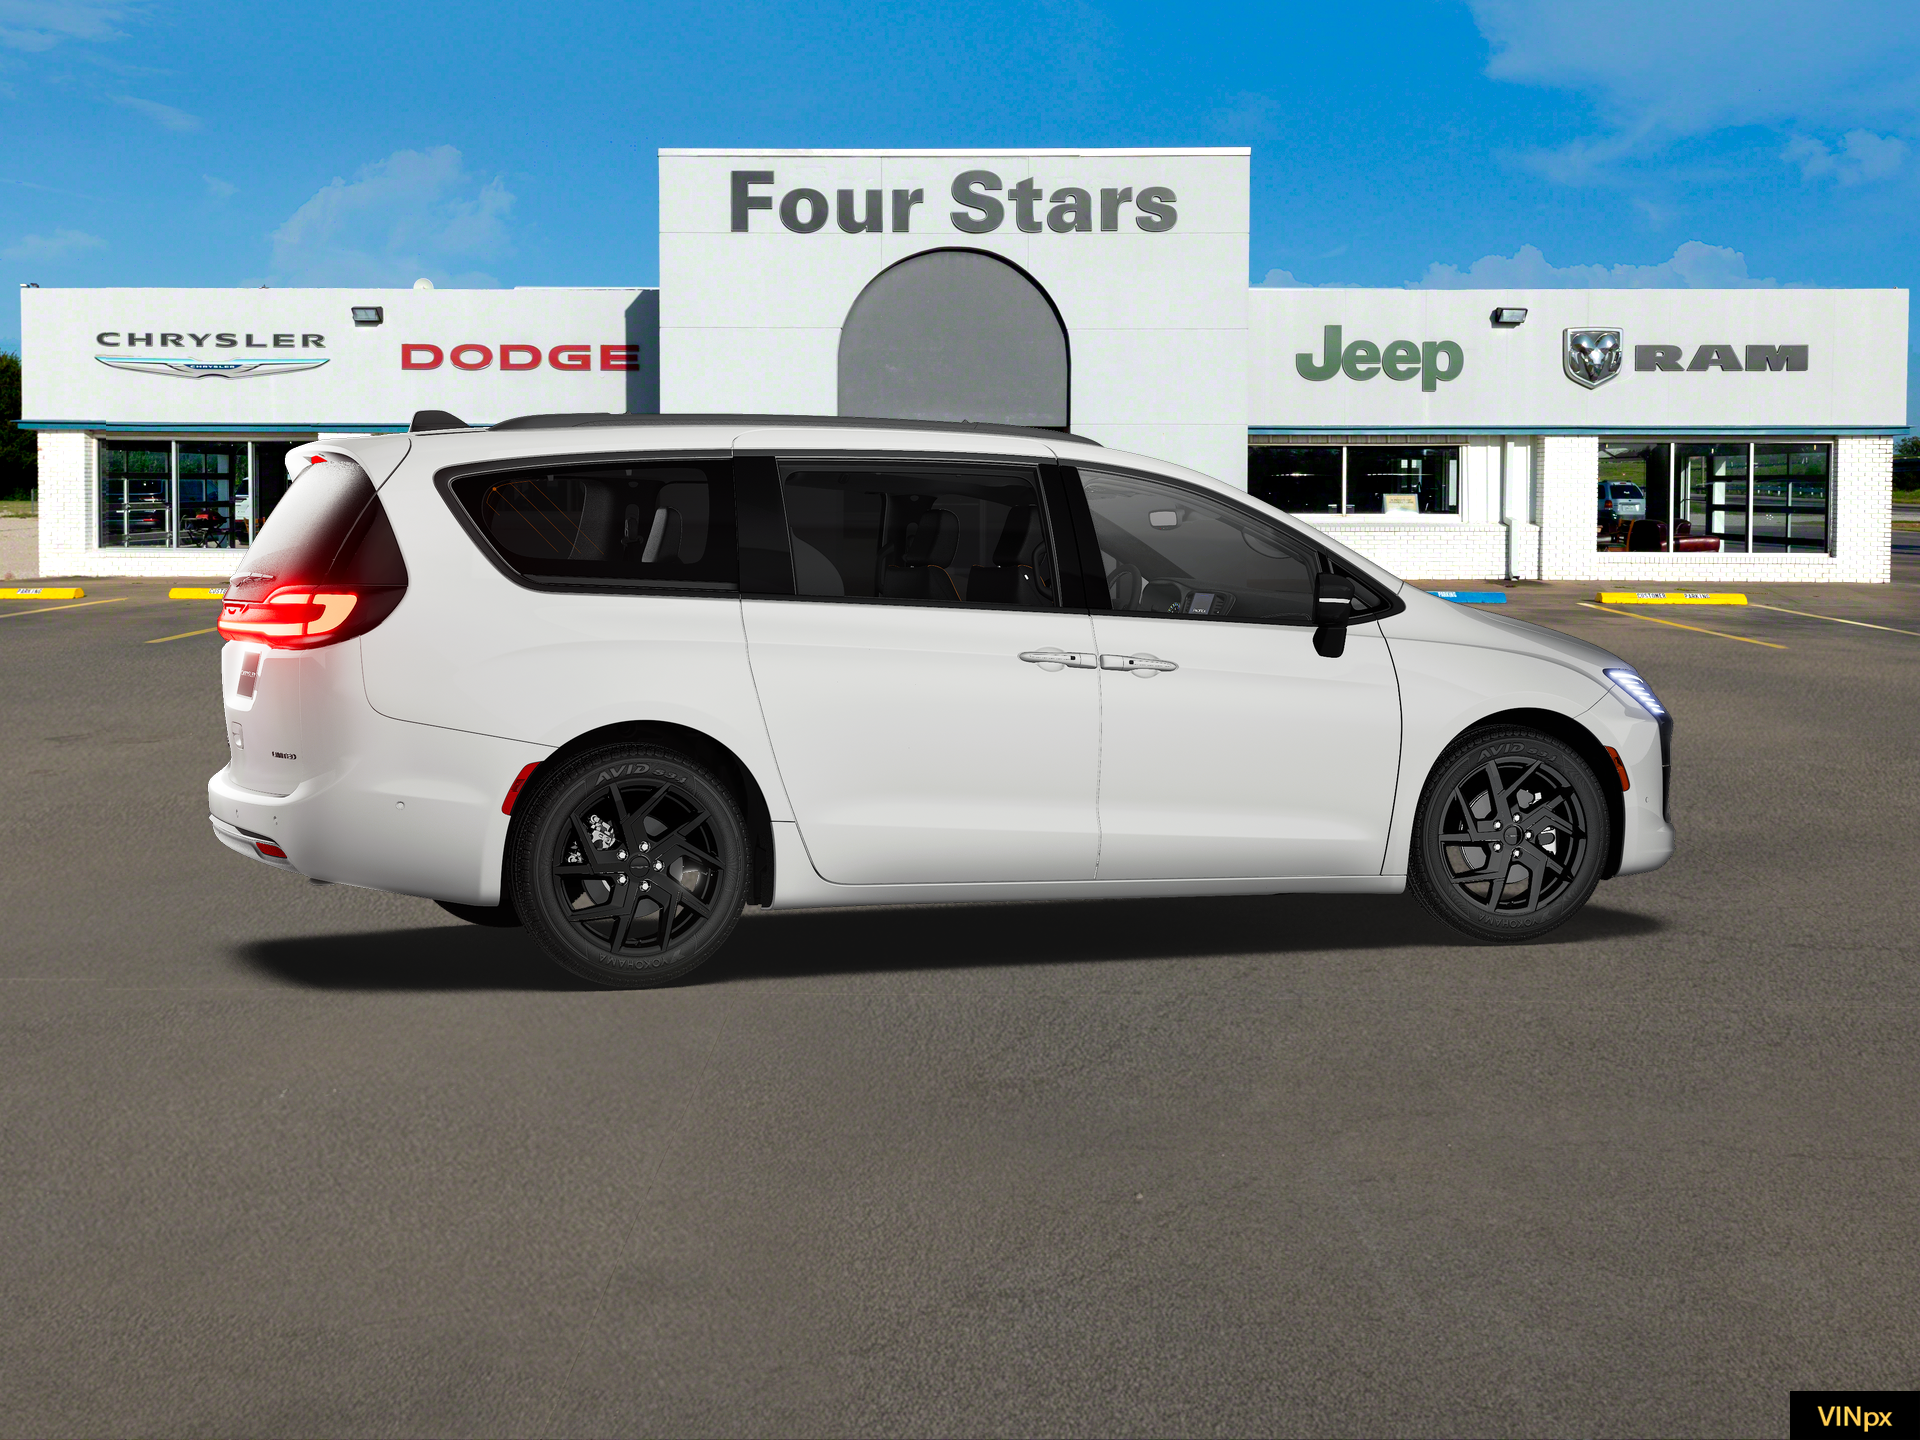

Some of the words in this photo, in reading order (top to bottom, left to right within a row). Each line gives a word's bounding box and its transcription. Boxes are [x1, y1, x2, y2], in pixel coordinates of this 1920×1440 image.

[731, 170, 925, 234] Four
[950, 169, 1178, 234] Stars
[96, 332, 326, 349] CHRYSLER
[401, 343, 640, 371] DODGE
[1295, 324, 1464, 393] Jeep
[1634, 344, 1809, 372] RAM
[1477, 742, 1526, 763] AVID
[595, 763, 651, 786] AVID
[1478, 912, 1538, 929] YOKOHAMA
[598, 952, 669, 971] YOKOHAMA
